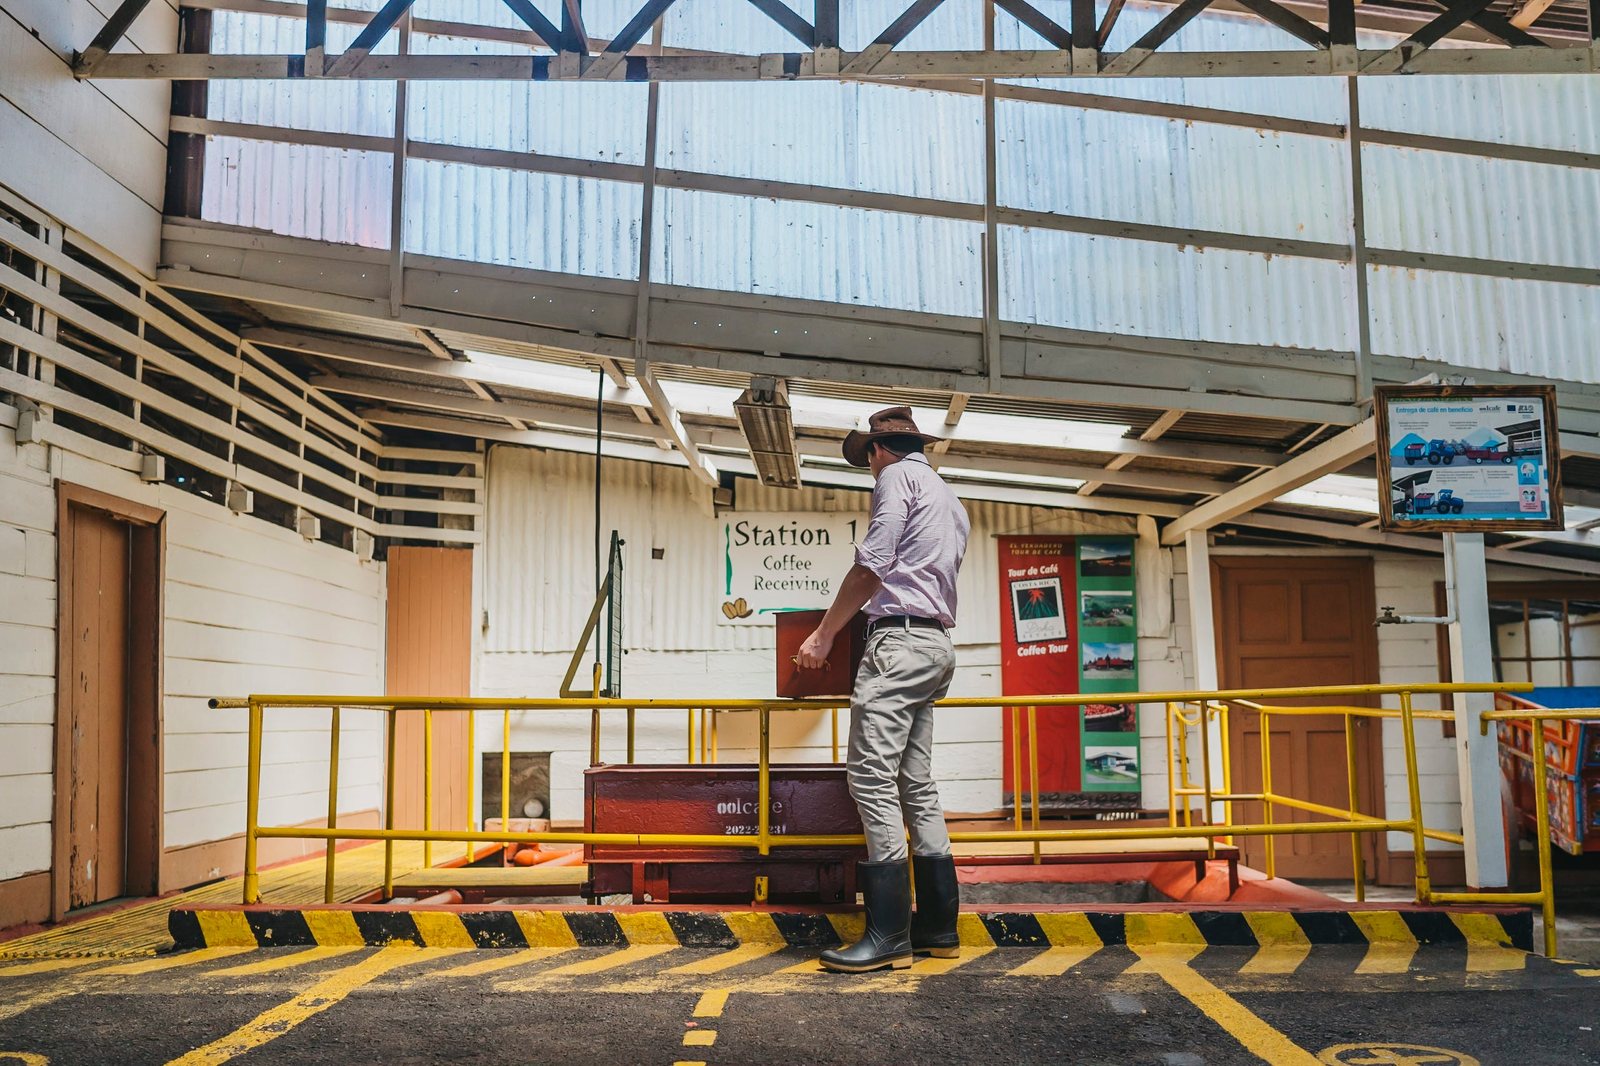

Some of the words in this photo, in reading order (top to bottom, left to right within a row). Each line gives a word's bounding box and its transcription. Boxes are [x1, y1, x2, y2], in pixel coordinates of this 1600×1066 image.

[734, 520, 831, 546] Station
[845, 520, 857, 545] 1
[763, 554, 812, 570] Coffee
[1008, 568, 1026, 578] Tour
[1028, 566, 1038, 576] de
[1040, 564, 1058, 574] Café
[754, 576, 830, 596] Receiving
[1017, 644, 1046, 657] Coffee
[1048, 644, 1068, 654] Tour
